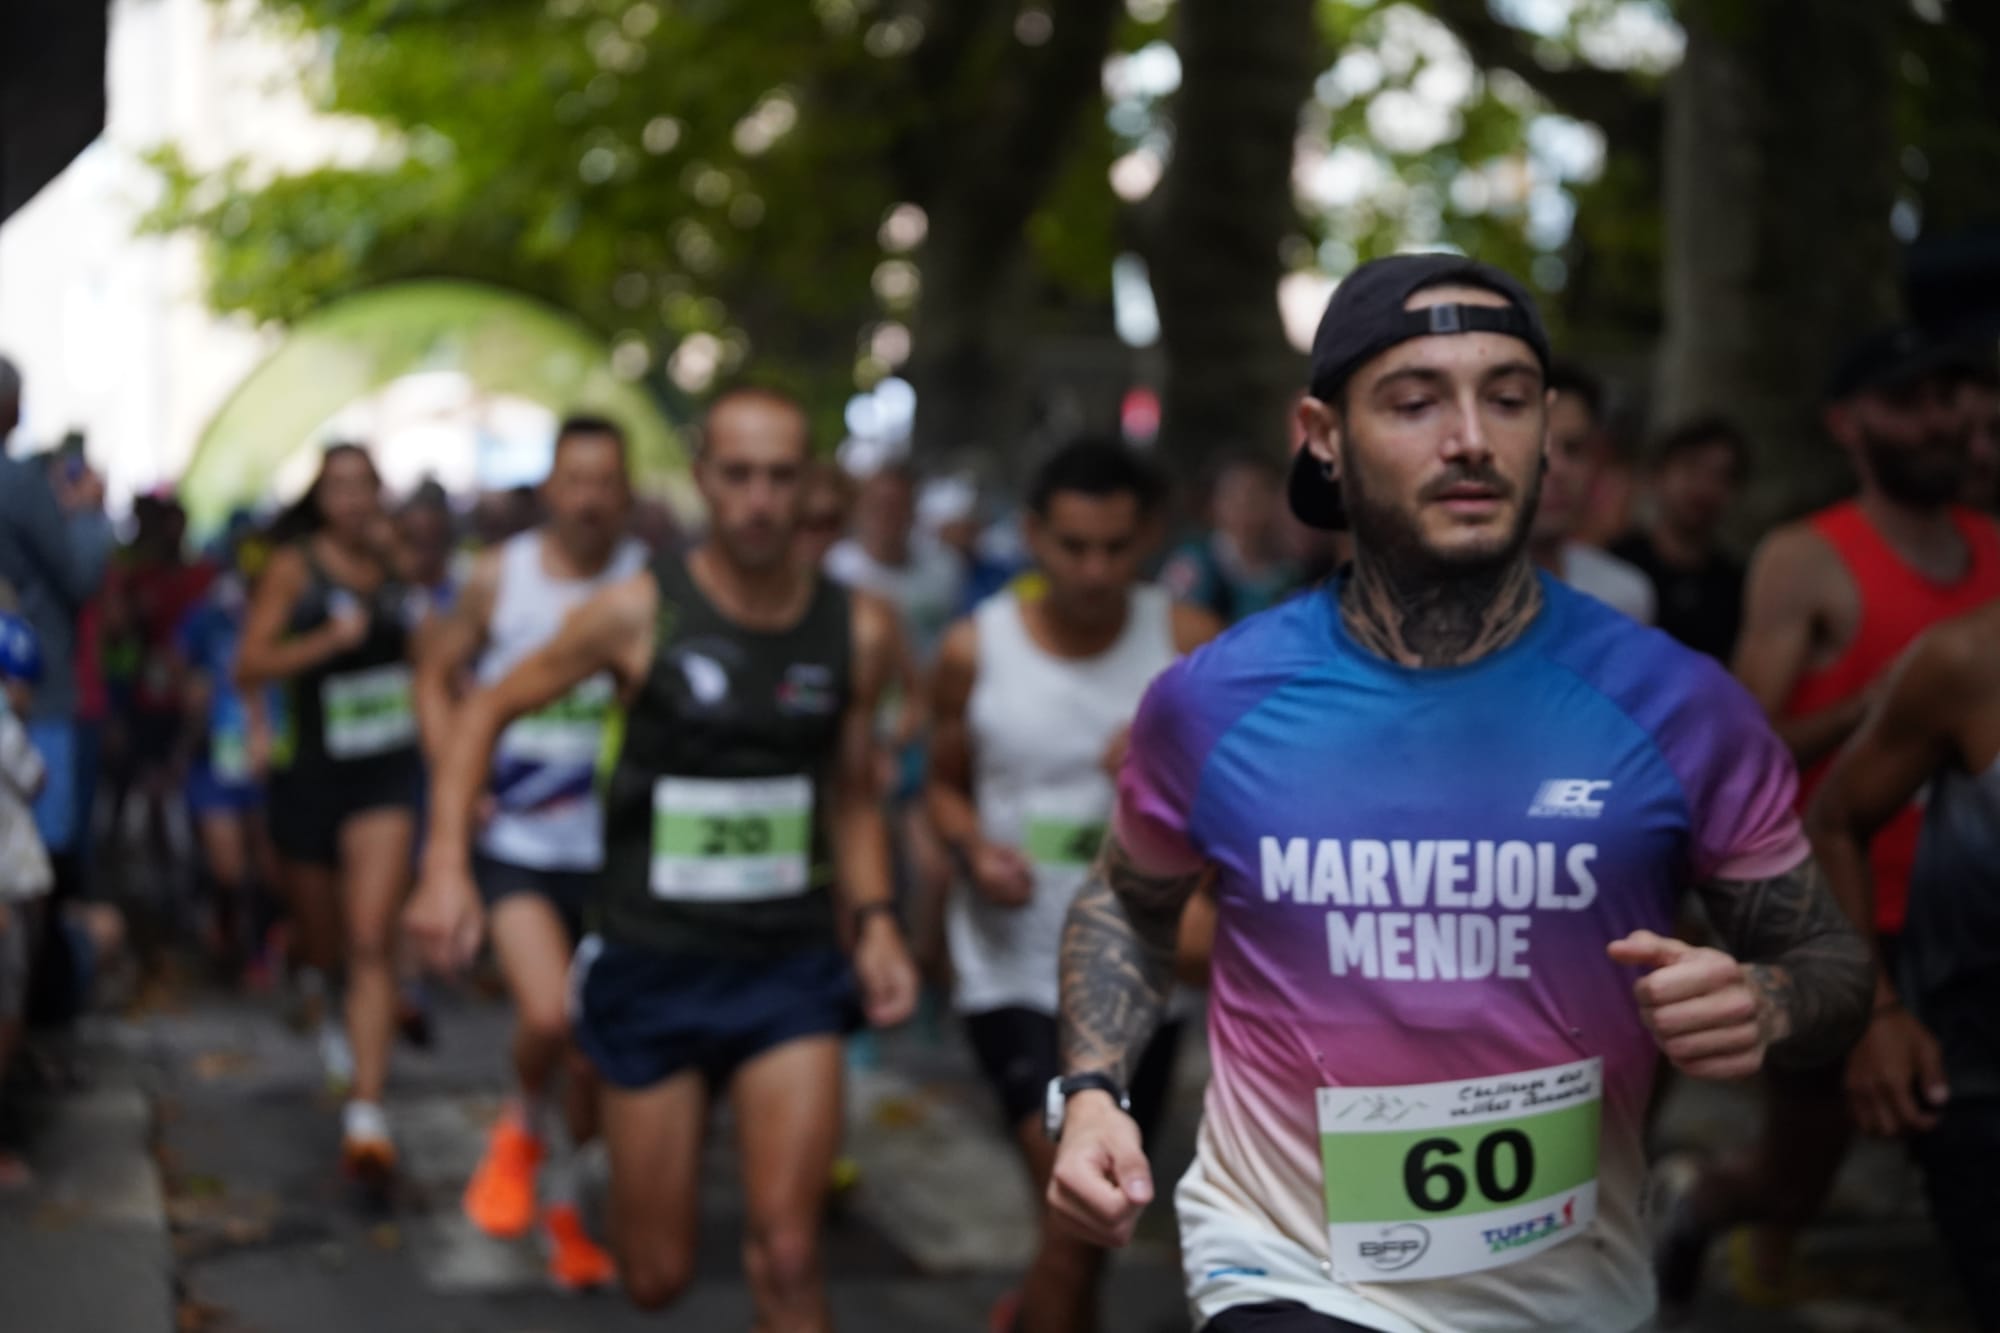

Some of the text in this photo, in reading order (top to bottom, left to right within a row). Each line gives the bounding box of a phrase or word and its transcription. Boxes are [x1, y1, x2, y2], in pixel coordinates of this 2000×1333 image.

[1259, 836, 1598, 910] MARVEJOLS
[1326, 910, 1532, 981] MENDE
[1402, 1128, 1535, 1213] 60
